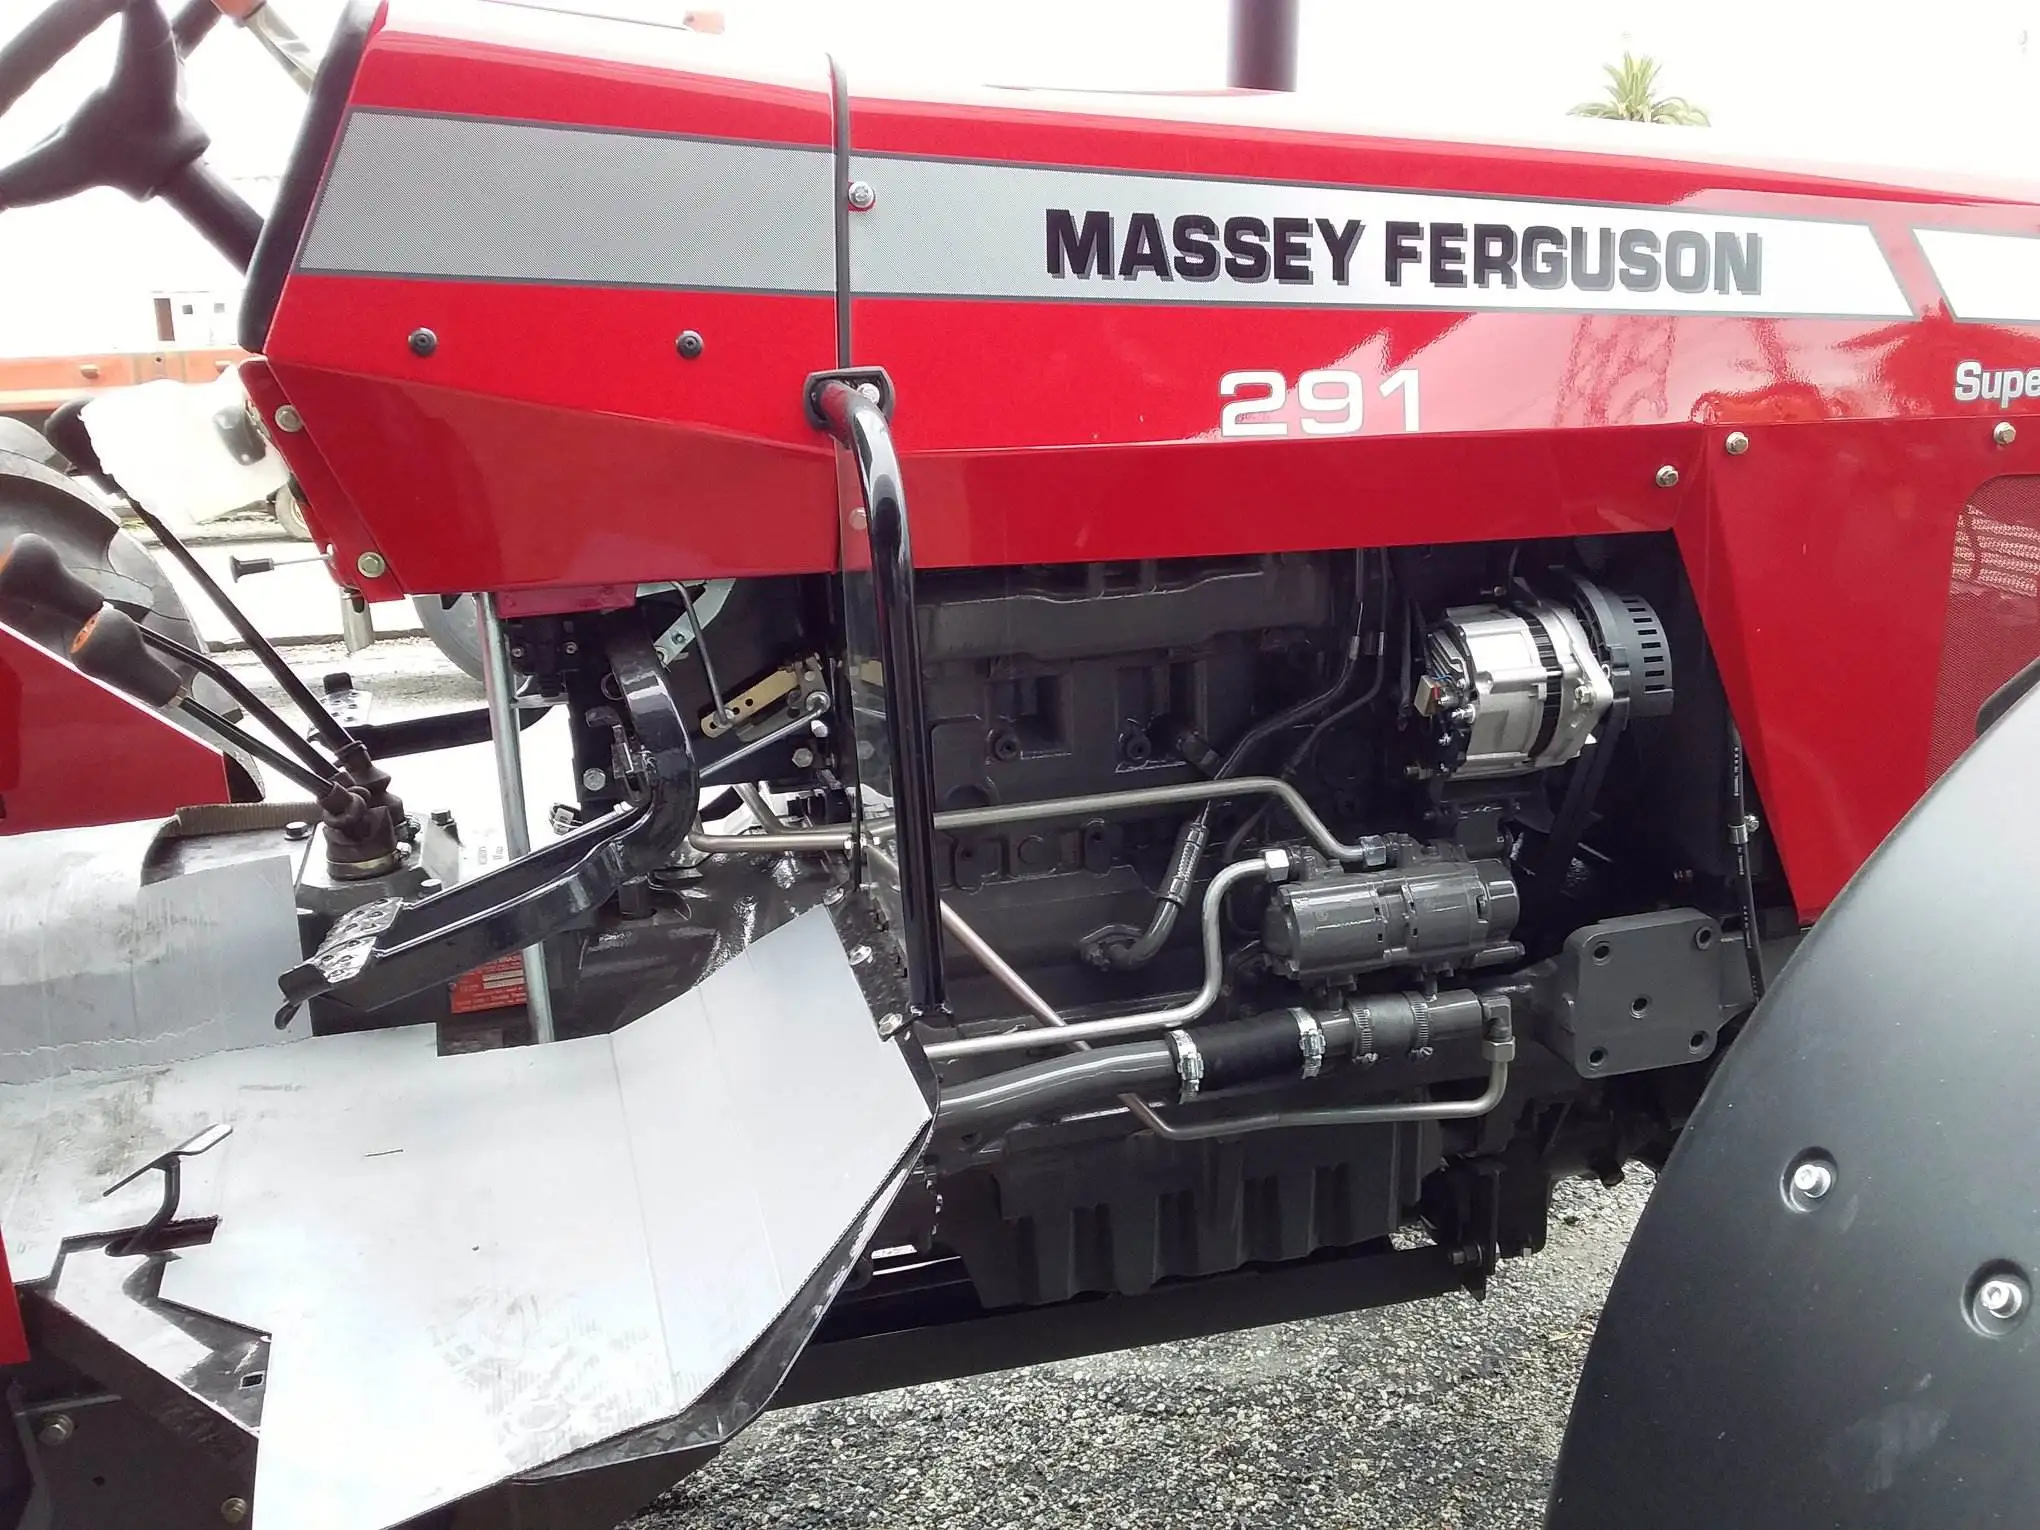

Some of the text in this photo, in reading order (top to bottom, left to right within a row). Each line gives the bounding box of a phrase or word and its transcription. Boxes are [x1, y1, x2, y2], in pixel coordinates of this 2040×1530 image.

[1046, 208, 1762, 295] MASSEY FERGUSON
[1219, 369, 1420, 437] 291
